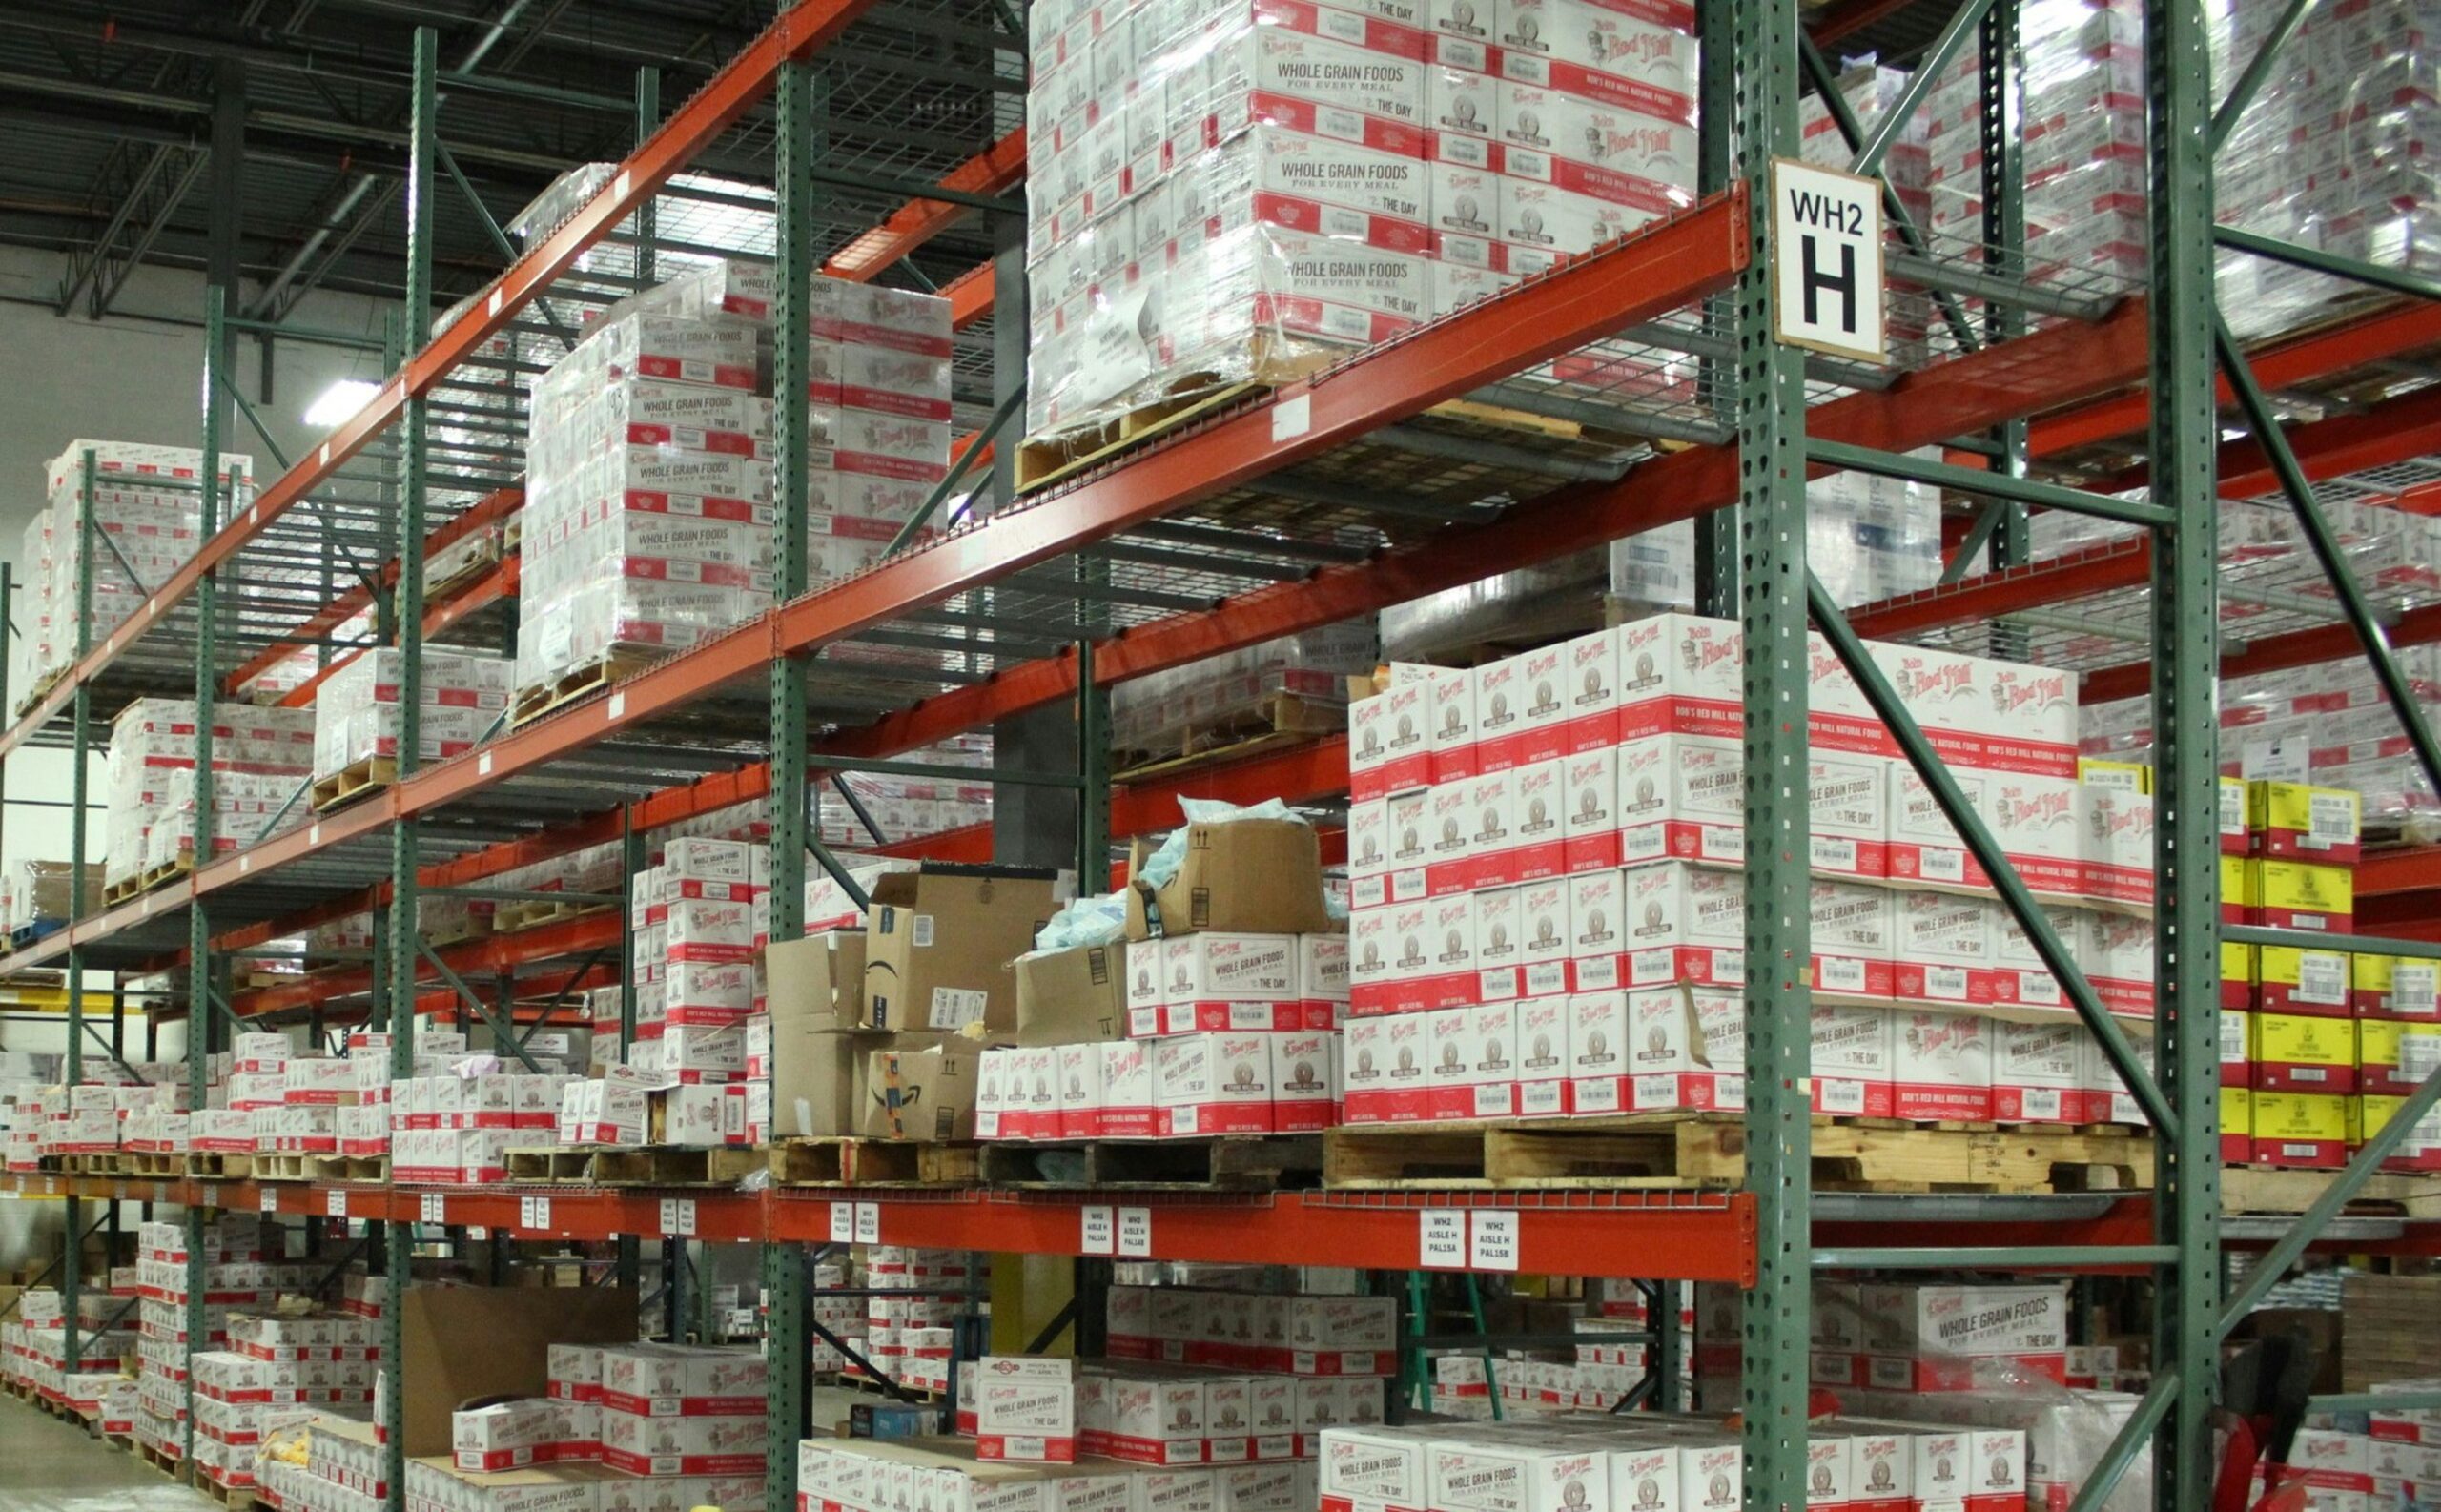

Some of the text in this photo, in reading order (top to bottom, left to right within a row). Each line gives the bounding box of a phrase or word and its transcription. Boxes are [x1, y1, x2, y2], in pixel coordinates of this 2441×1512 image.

[1379, 2, 1413, 20] THE DAY
[1278, 63, 1403, 82] WHOLE GRAIN FOODS
[1360, 83, 1393, 92] MEAL
[1378, 99, 1411, 117] THE DAY
[1282, 163, 1408, 179] WHOLE GRAIN FOODS
[1383, 198, 1417, 215] THE DAY
[1790, 188, 1863, 236] WH2
[1330, 263, 1365, 277] GRAIN
[1369, 264, 1407, 277] FOODS
[1801, 235, 1856, 333] H
[1384, 296, 1418, 314] THE DAY
[643, 397, 733, 412] WHOLE GRAIN FOODS
[640, 461, 729, 478] WHOLE GRAIN FOODS
[638, 528, 728, 545] WHOLE GRAIN FOODS
[1676, 706, 1695, 717] BOB'S
[1697, 707, 1710, 718] RED
[1712, 709, 1726, 720] MILL
[1821, 722, 1835, 732] MILL
[1836, 725, 1860, 736] NATURAL
[1862, 727, 1881, 739] FOODS
[1938, 739, 1961, 749] NATURAL
[1963, 742, 1980, 751] FOODS
[1988, 745, 2004, 755] BOB'S
[2005, 747, 2017, 756] RED
[2019, 749, 2031, 758] MILL
[1688, 774, 1713, 790] WHOLE
[1716, 772, 1737, 786] GRAIN
[1824, 784, 1847, 798] GRAIN
[1848, 780, 1871, 794] FOODS
[1908, 799, 1931, 813] WHOLE
[1844, 811, 1872, 824] THE DAY
[1698, 901, 1723, 916] WHOLE
[1834, 904, 1856, 918] GRAIN
[1856, 899, 1878, 914] FOODS
[1913, 909, 1981, 933] WHOLE GRAIN FOODS
[1853, 931, 1880, 943] THE DAY
[1956, 941, 1981, 952] THE DAY
[1215, 950, 1284, 976] WHOLE GRAIN FOODS
[1321, 961, 1340, 976] WHOLE
[1260, 978, 1286, 989] THE DAY
[1834, 1025, 1855, 1040] GRAIN
[1856, 1020, 1877, 1034] FOODS
[1853, 1052, 1878, 1064] THE DAY
[1920, 1093, 1931, 1103] RED
[1933, 1094, 1945, 1104] MILL
[1486, 1222, 1504, 1232] WH2
[1480, 1236, 1501, 1244] AISLE
[1939, 1297, 2049, 1338] WHOLE GRAIN FOODS
[2026, 1335, 2056, 1346] THE DAY
[994, 1395, 1059, 1415] WHOLE GRAIN FOODS
[1047, 1418, 1060, 1426] DAY
[1339, 1457, 1402, 1477] WHOLE GRAIN FOODS
[1447, 1467, 1517, 1490] WHOLE GRAIN FOODS
[1381, 1484, 1402, 1496] THE DAY
[1493, 1497, 1517, 1509] THE DAY
